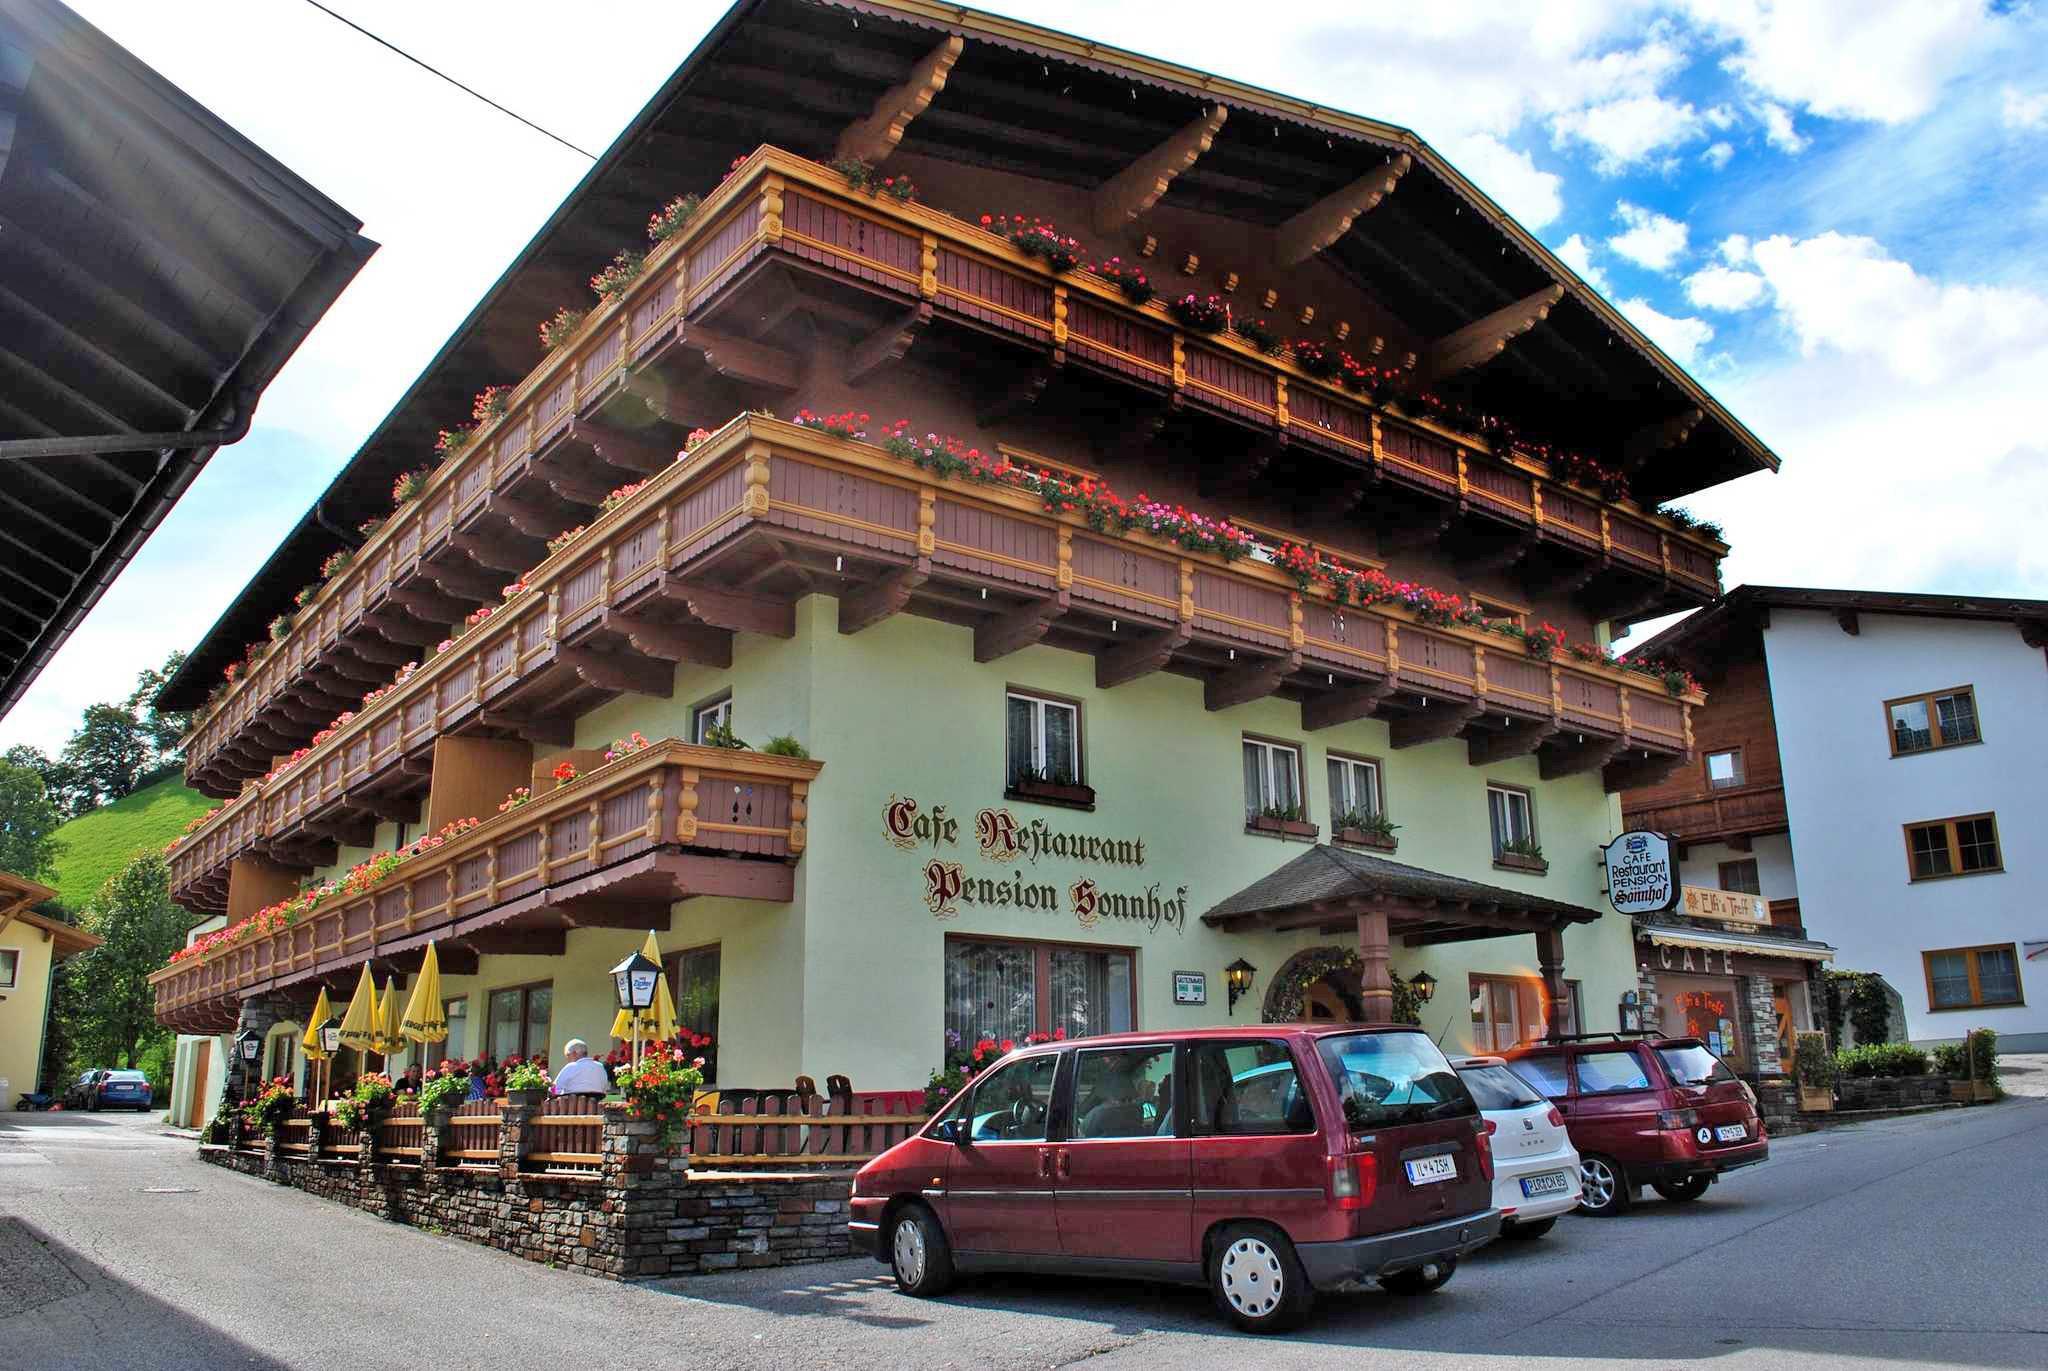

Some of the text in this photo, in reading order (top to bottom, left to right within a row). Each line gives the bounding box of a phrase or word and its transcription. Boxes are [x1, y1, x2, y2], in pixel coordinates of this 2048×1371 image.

[885, 796, 957, 849] Cafe
[1612, 859, 1666, 879] Restaurant
[1622, 852, 1651, 865] CAFE
[1613, 873, 1668, 889] PENSION
[926, 861, 1187, 935] Pension Sonnhof
[1660, 945, 1734, 975] CAFE
